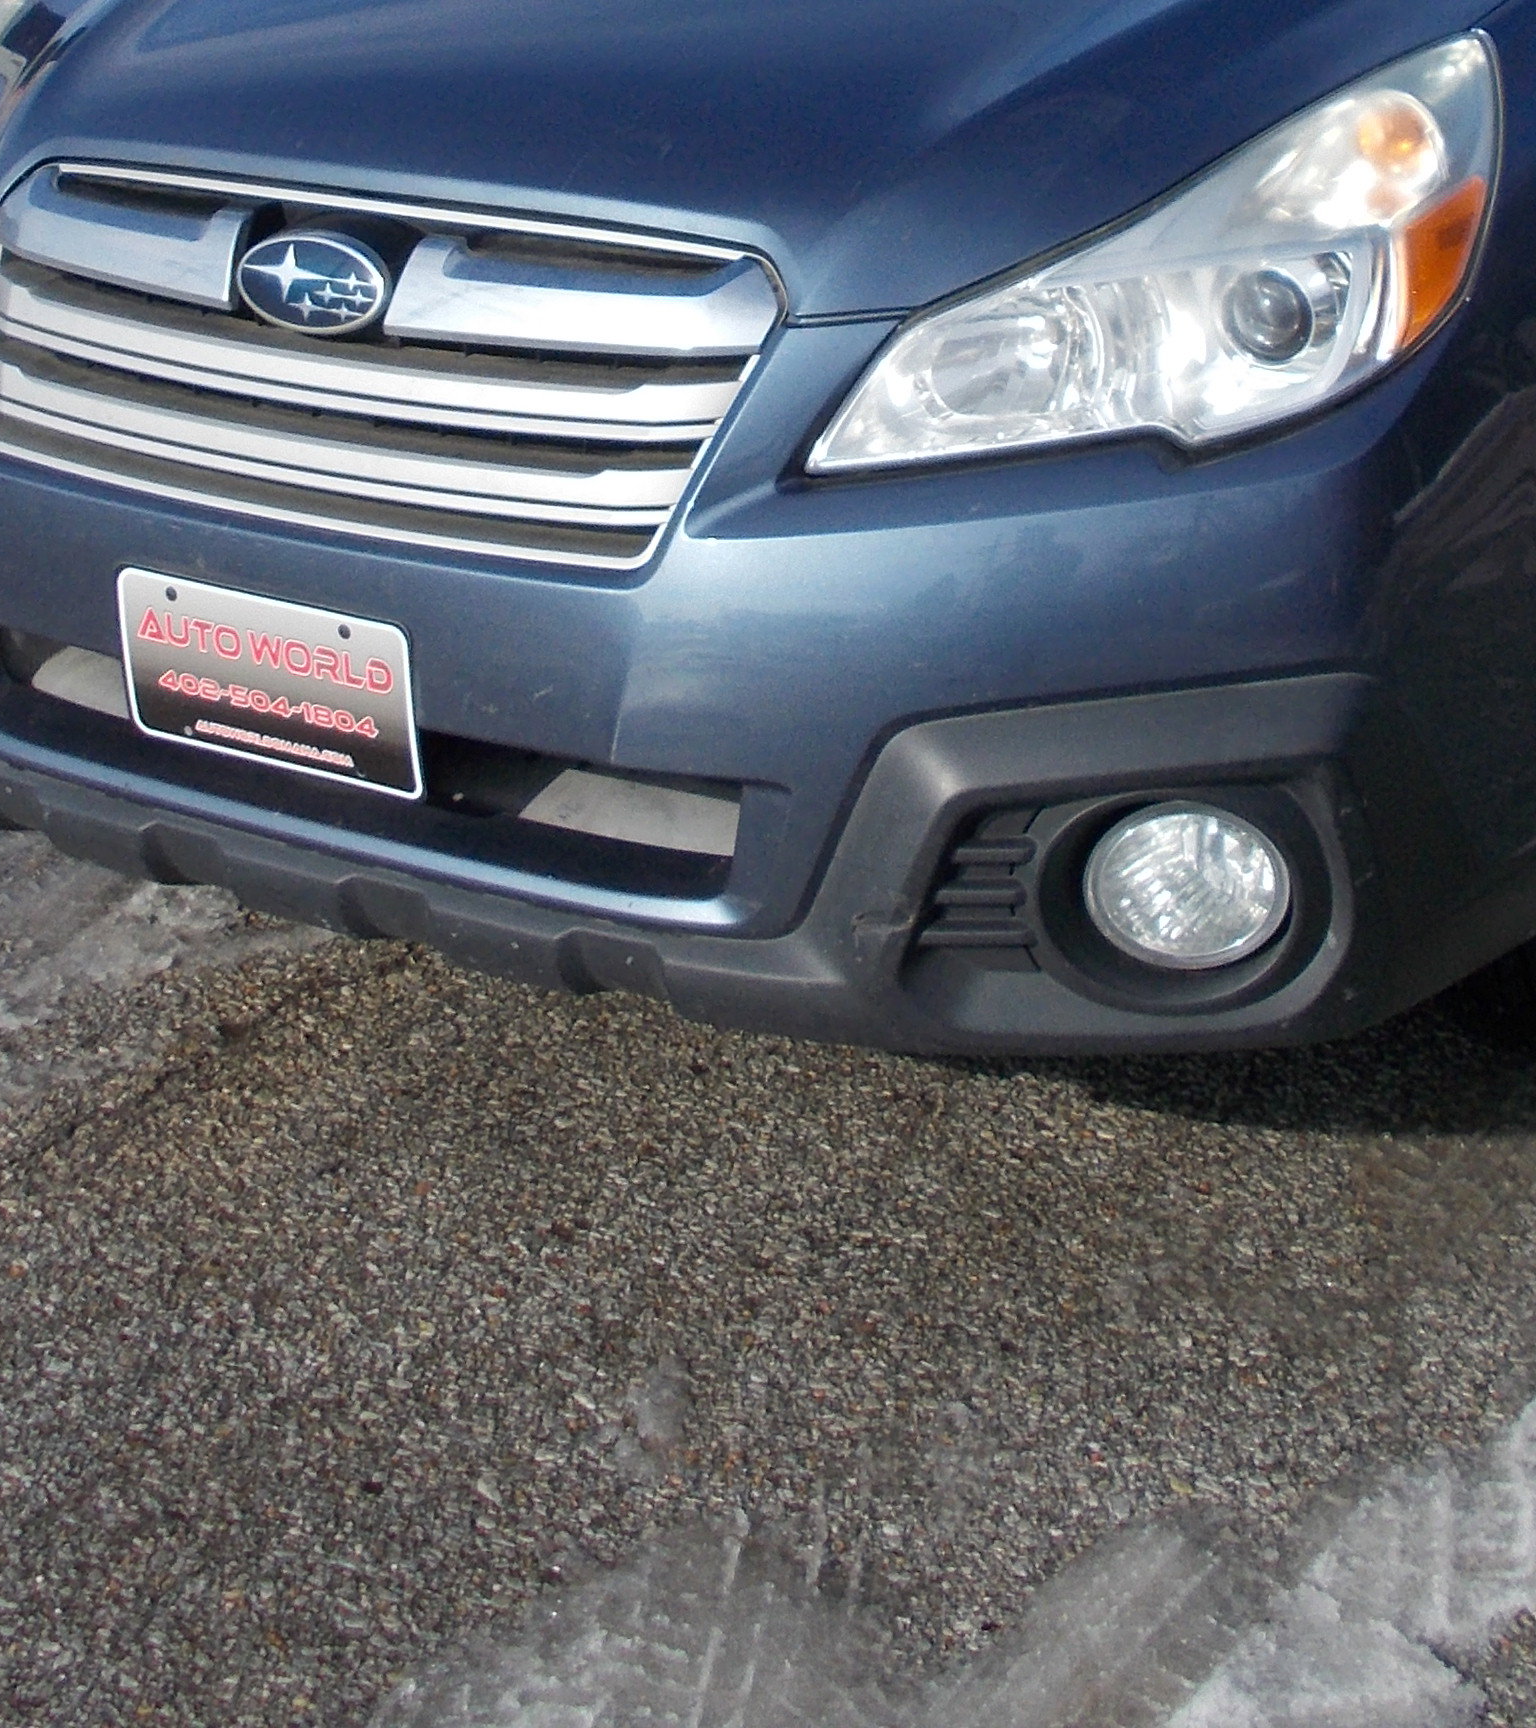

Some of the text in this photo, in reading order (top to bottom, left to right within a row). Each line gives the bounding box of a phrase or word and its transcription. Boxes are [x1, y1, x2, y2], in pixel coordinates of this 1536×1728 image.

[137, 606, 395, 695] AUTO WORLD
[158, 668, 380, 739] 402-504-1804
